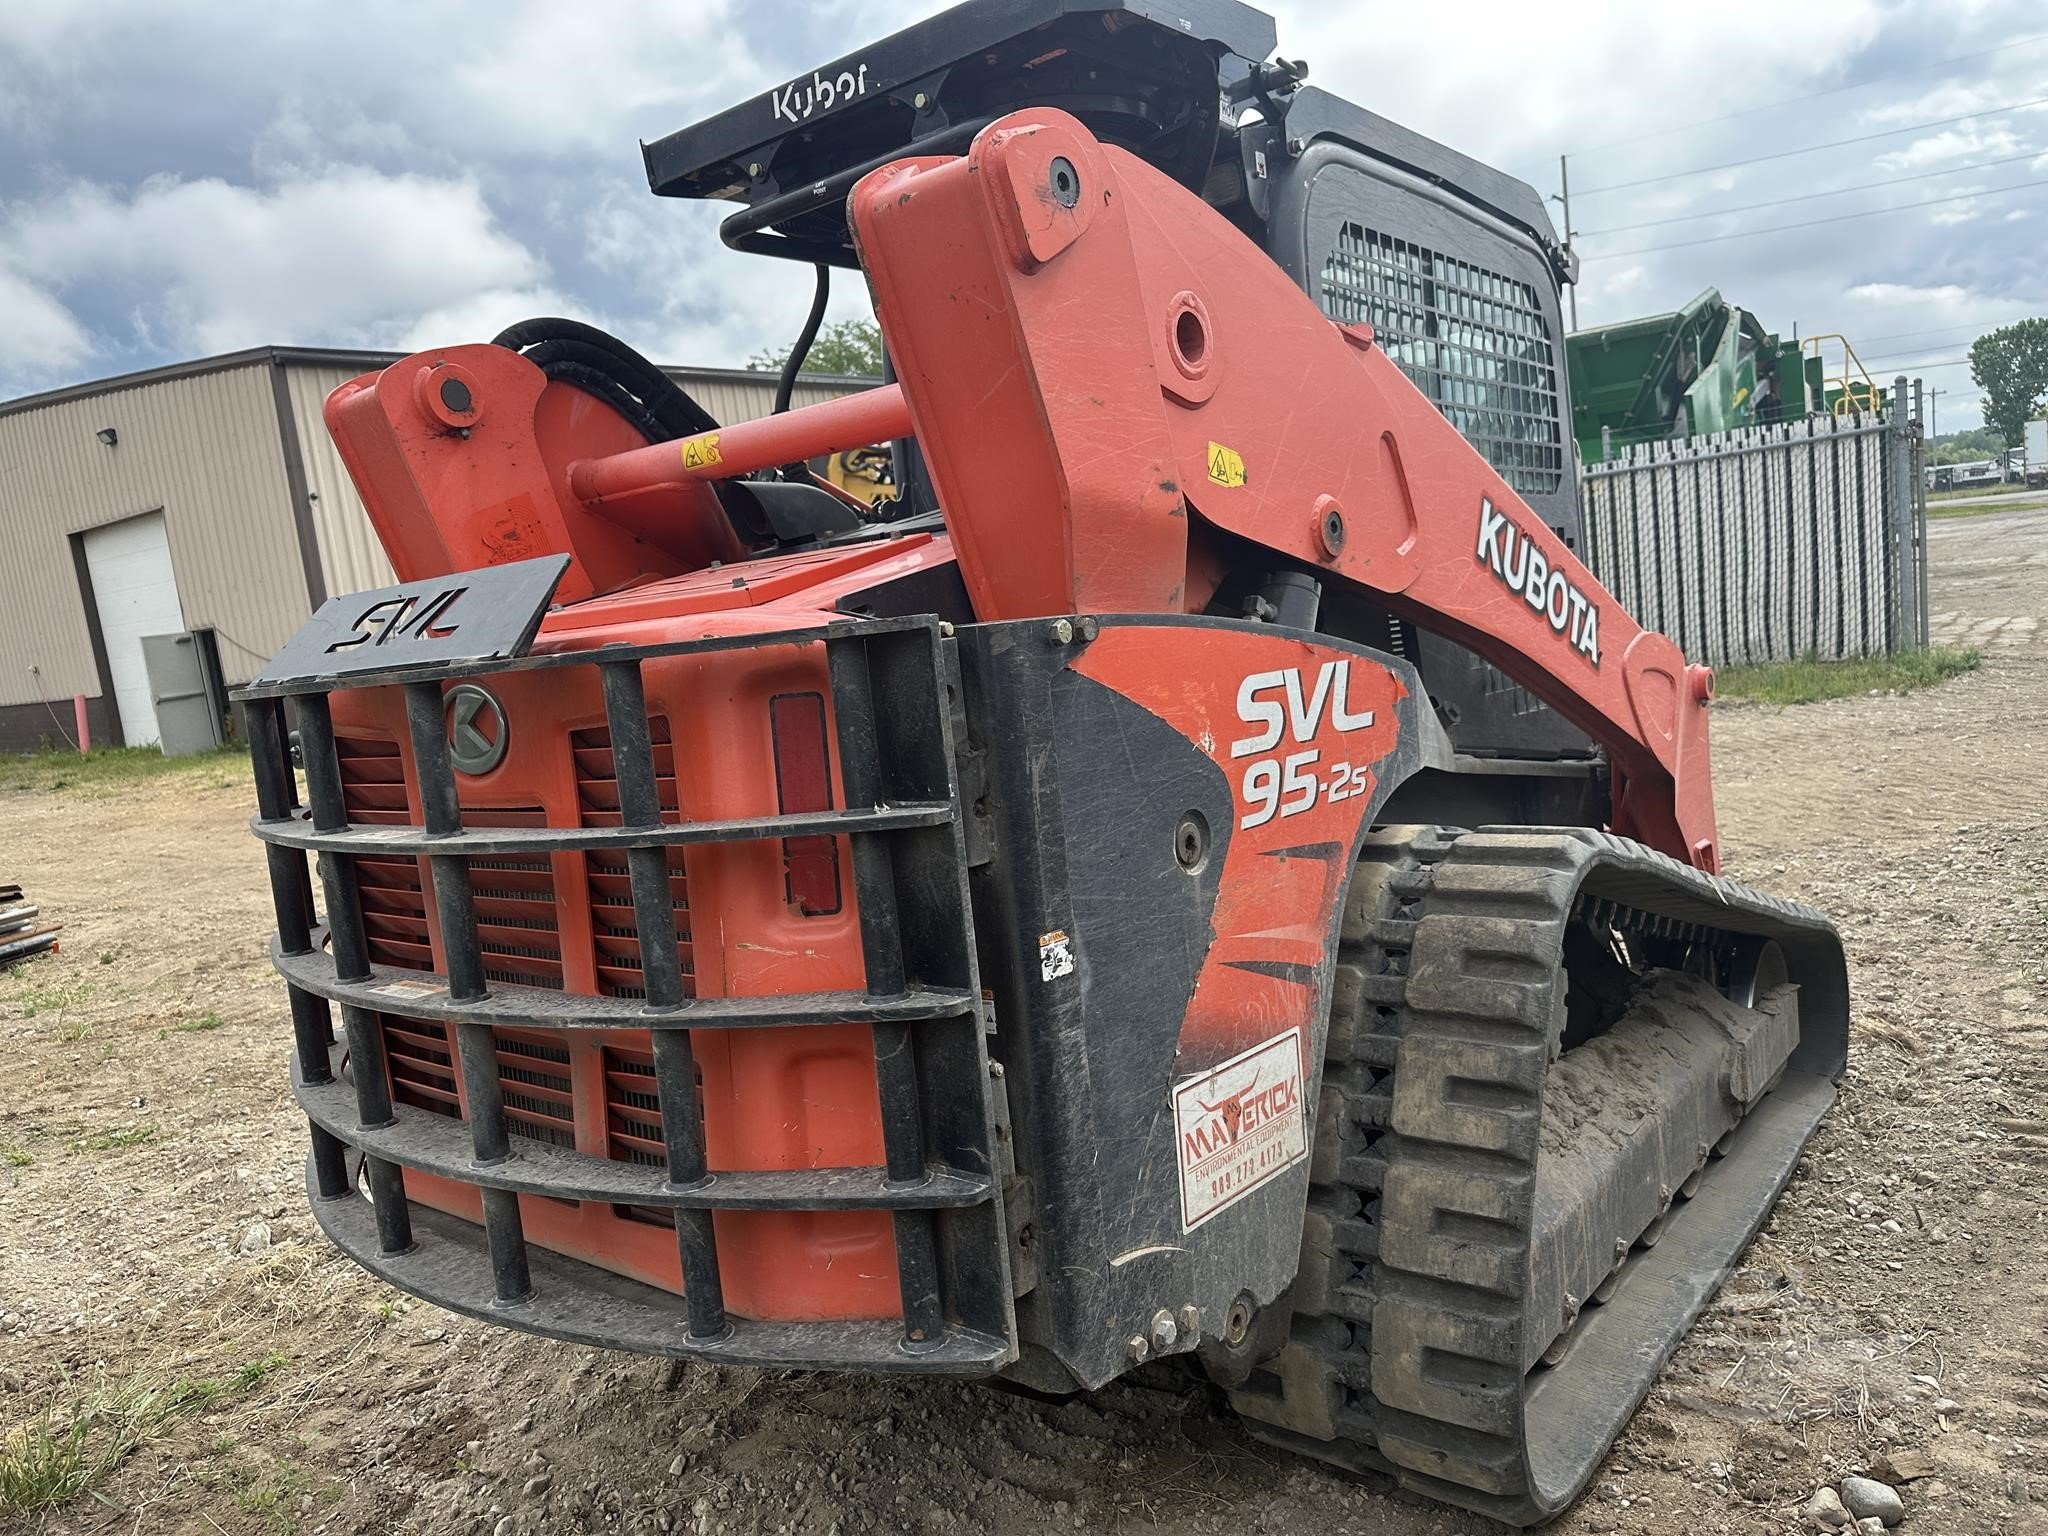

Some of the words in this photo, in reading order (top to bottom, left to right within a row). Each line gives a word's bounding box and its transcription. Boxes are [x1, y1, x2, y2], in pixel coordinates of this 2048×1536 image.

[323, 586, 470, 654] SVL
[1476, 497, 1599, 665] KUBOTA
[1230, 659, 1375, 759] SVL
[1184, 1074, 1298, 1166] MAVERICK
[1195, 1138, 1255, 1183] ENVIRONMENTAL
[1256, 1115, 1293, 1146] EQUIPMENT
[1211, 1139, 1284, 1199] 989.272.4173
